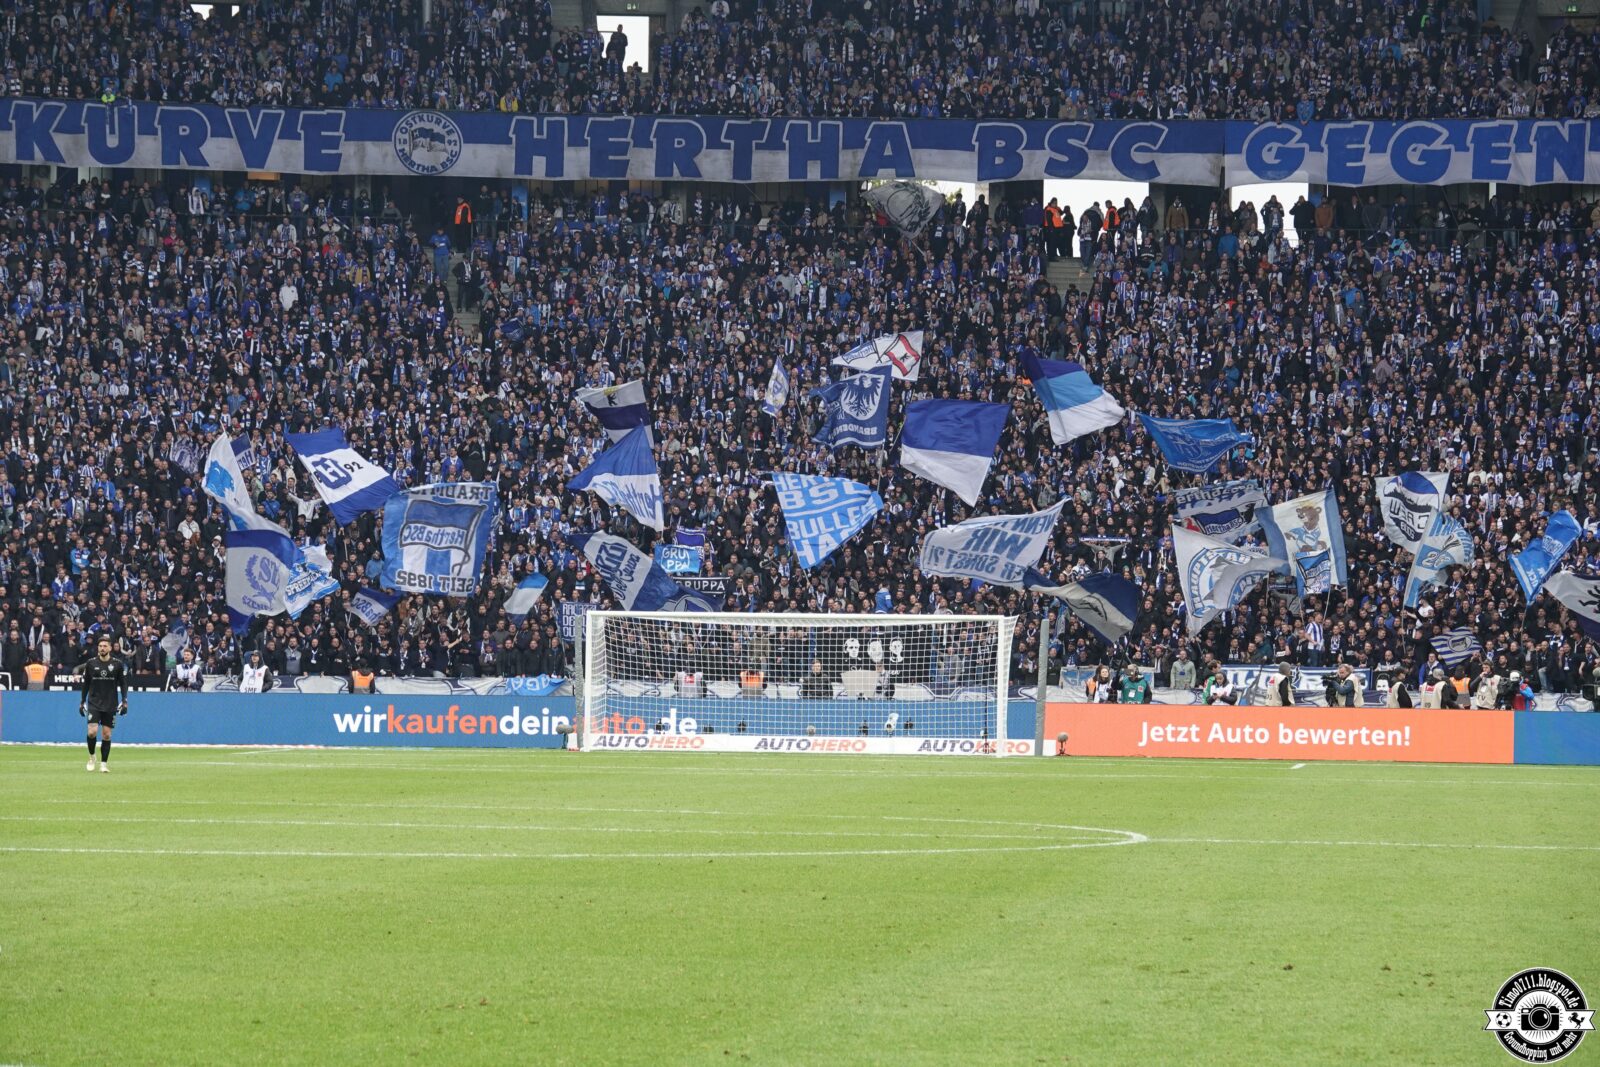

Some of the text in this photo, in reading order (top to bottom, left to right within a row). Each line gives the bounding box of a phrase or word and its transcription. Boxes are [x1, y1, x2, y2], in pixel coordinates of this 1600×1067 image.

[400, 114, 455, 137] OSTKURVE
[9, 101, 1590, 183] KURVE HERTHA BSC GEGEN
[399, 147, 457, 173] HERTHA BSC
[662, 547, 686, 560] GRU
[333, 705, 698, 736] wirkaufendeinuto.de
[593, 735, 705, 749] AUTOHERO
[754, 737, 867, 751] AUTOHERO
[1139, 721, 1411, 747] Jetzt Auto bewerten!
